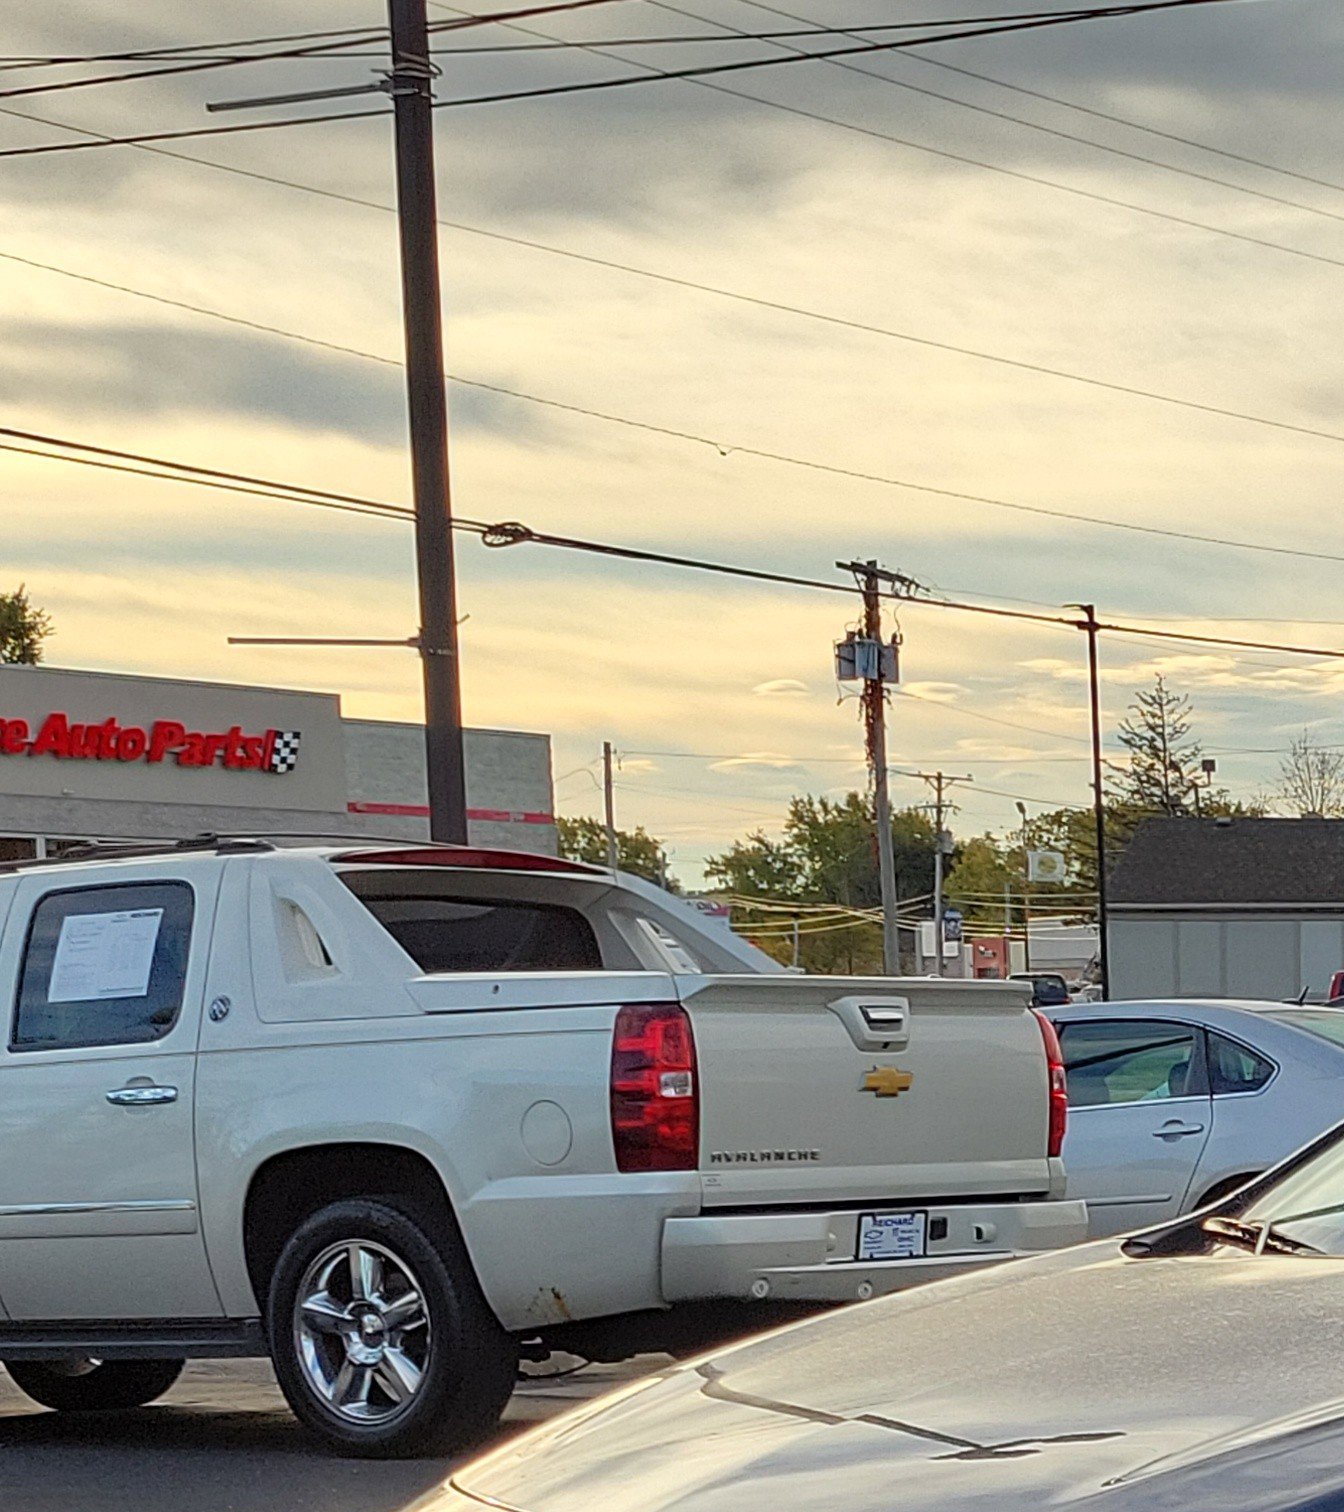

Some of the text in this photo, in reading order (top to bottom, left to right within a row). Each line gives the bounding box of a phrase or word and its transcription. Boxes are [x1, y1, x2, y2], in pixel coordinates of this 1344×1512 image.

[30, 712, 147, 761] Auto
[147, 720, 264, 769] Parts
[710, 1149, 820, 1163] AVALANCHE
